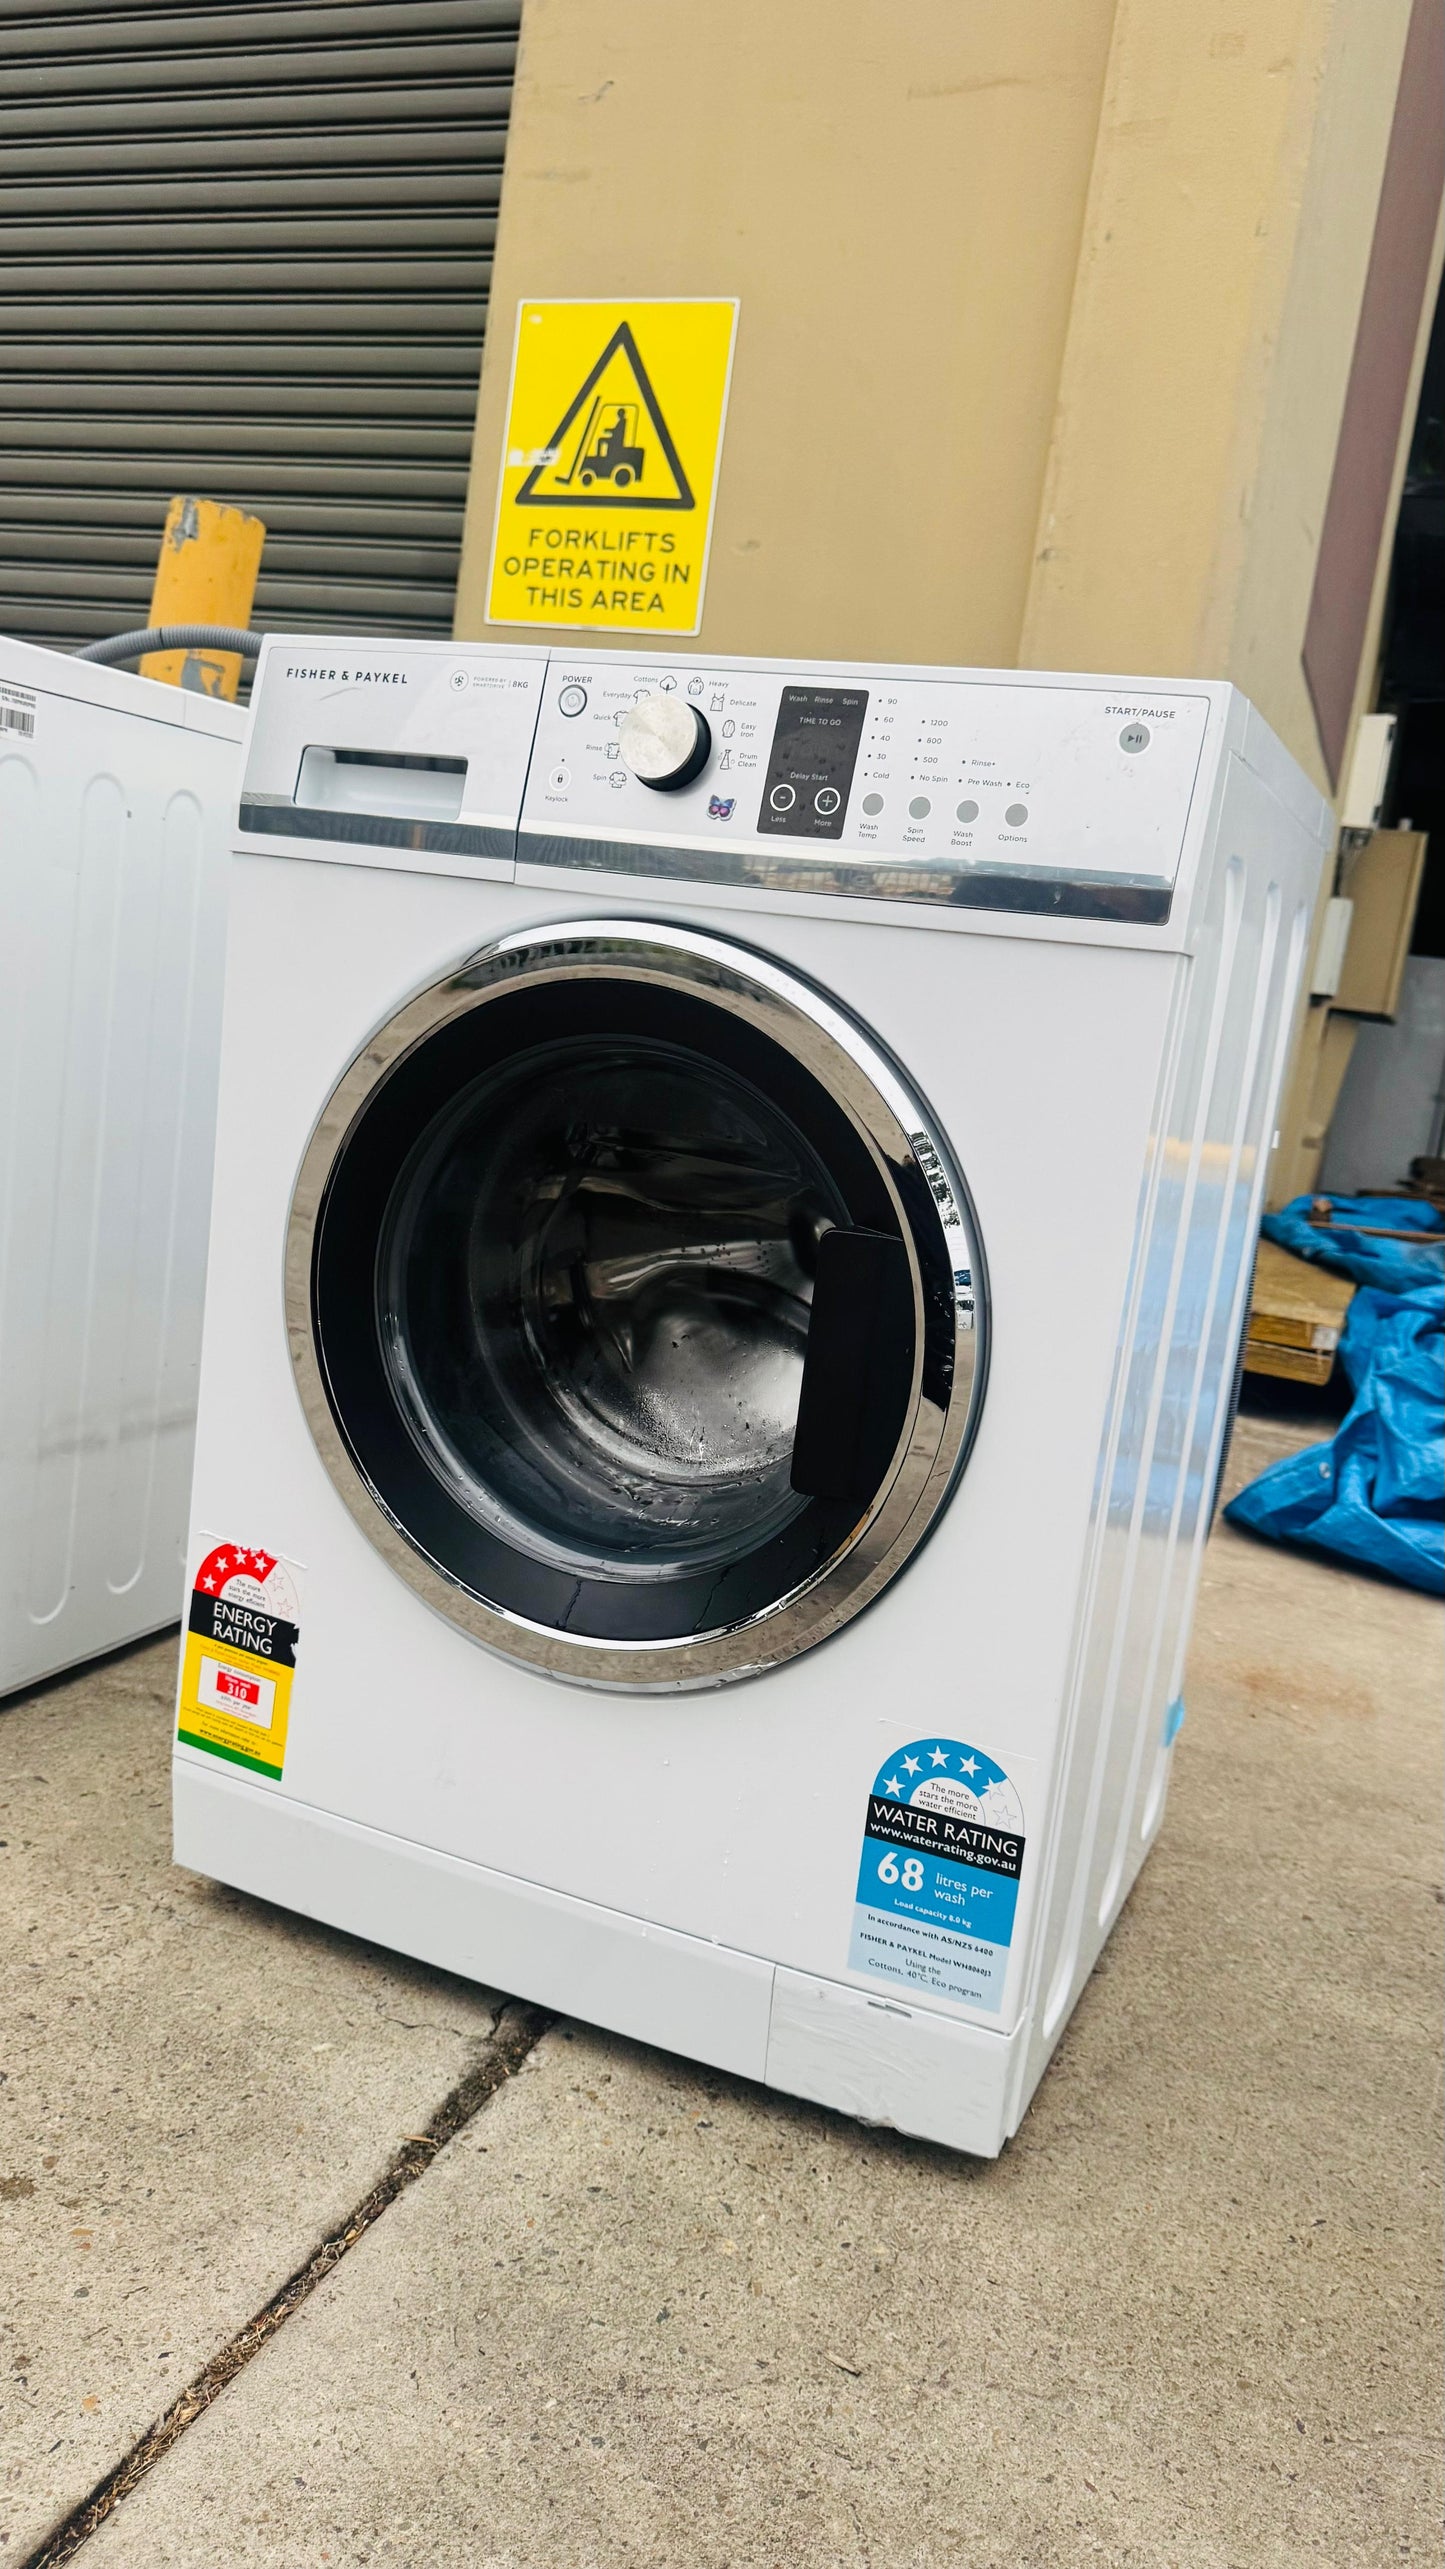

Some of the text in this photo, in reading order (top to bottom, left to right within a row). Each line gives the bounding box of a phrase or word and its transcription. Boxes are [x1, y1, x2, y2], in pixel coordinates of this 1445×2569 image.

[528, 528, 676, 553] FORKLIFTS
[503, 557, 690, 584] OPERATING IN
[526, 587, 664, 613] THIS AREA
[286, 668, 408, 684] FISHER & PAYKEL
[562, 675, 593, 684] POWER
[633, 675, 658, 684] Cottons
[512, 681, 529, 689] 8KG
[708, 680, 729, 688] Heavy
[602, 691, 632, 700] Everyday
[788, 694, 858, 707] Wash Rinse Spin
[729, 699, 757, 707] Delicate
[887, 697, 898, 705] 90
[593, 713, 611, 721] Quick
[1104, 706, 1176, 719] START/PAUSE
[799, 716, 841, 727] TIME TO GO
[930, 719, 948, 727] 1200
[740, 723, 757, 732] Easy
[740, 730, 754, 738] Iron
[586, 744, 603, 752] Rinse
[739, 752, 758, 760] Drum
[922, 756, 938, 764] 500
[738, 760, 757, 768] Clean
[592, 773, 607, 782] Spin
[790, 771, 829, 782] Delay Start
[872, 772, 890, 780] Cold
[919, 774, 948, 785] No Spin
[967, 778, 1003, 788] Pre Wash
[1015, 781, 1030, 790] Eco
[544, 795, 568, 803] Keylock
[770, 815, 787, 824] Less
[814, 818, 832, 827] More
[859, 823, 879, 832] Wash
[907, 827, 924, 836] Spin
[858, 831, 877, 841] Temp
[902, 835, 926, 844] Speed
[953, 830, 973, 839] Wash
[997, 833, 1028, 844] Options
[950, 839, 972, 847] Boost
[213, 1601, 277, 1636] ENERGY
[212, 1620, 273, 1655] RATING
[227, 1683, 247, 1700] 310
[930, 1782, 970, 1800] The more
[919, 1790, 978, 1812] stars the more
[918, 1799, 976, 1820] water efficient
[873, 1801, 1017, 1857] WATER RATING
[870, 1822, 1016, 1872] www.waterrating.gov.au
[877, 1851, 924, 1892] 68
[935, 1872, 994, 1900] litres per
[934, 1889, 966, 1907] wash
[894, 1898, 973, 1929] Load capacity 8.0 kg
[877, 1917, 920, 1935] accordance
[922, 1929, 939, 1940] with
[940, 1935, 973, 1951] AS/NZS
[974, 1946, 993, 1957] 6400
[860, 1932, 887, 1946] FISHER
[897, 1943, 927, 1958] PAYKEL
[928, 1953, 952, 1965] Model
[905, 1958, 941, 1976] Using the
[931, 1977, 947, 1988] Eco
[948, 1984, 982, 1999] program
